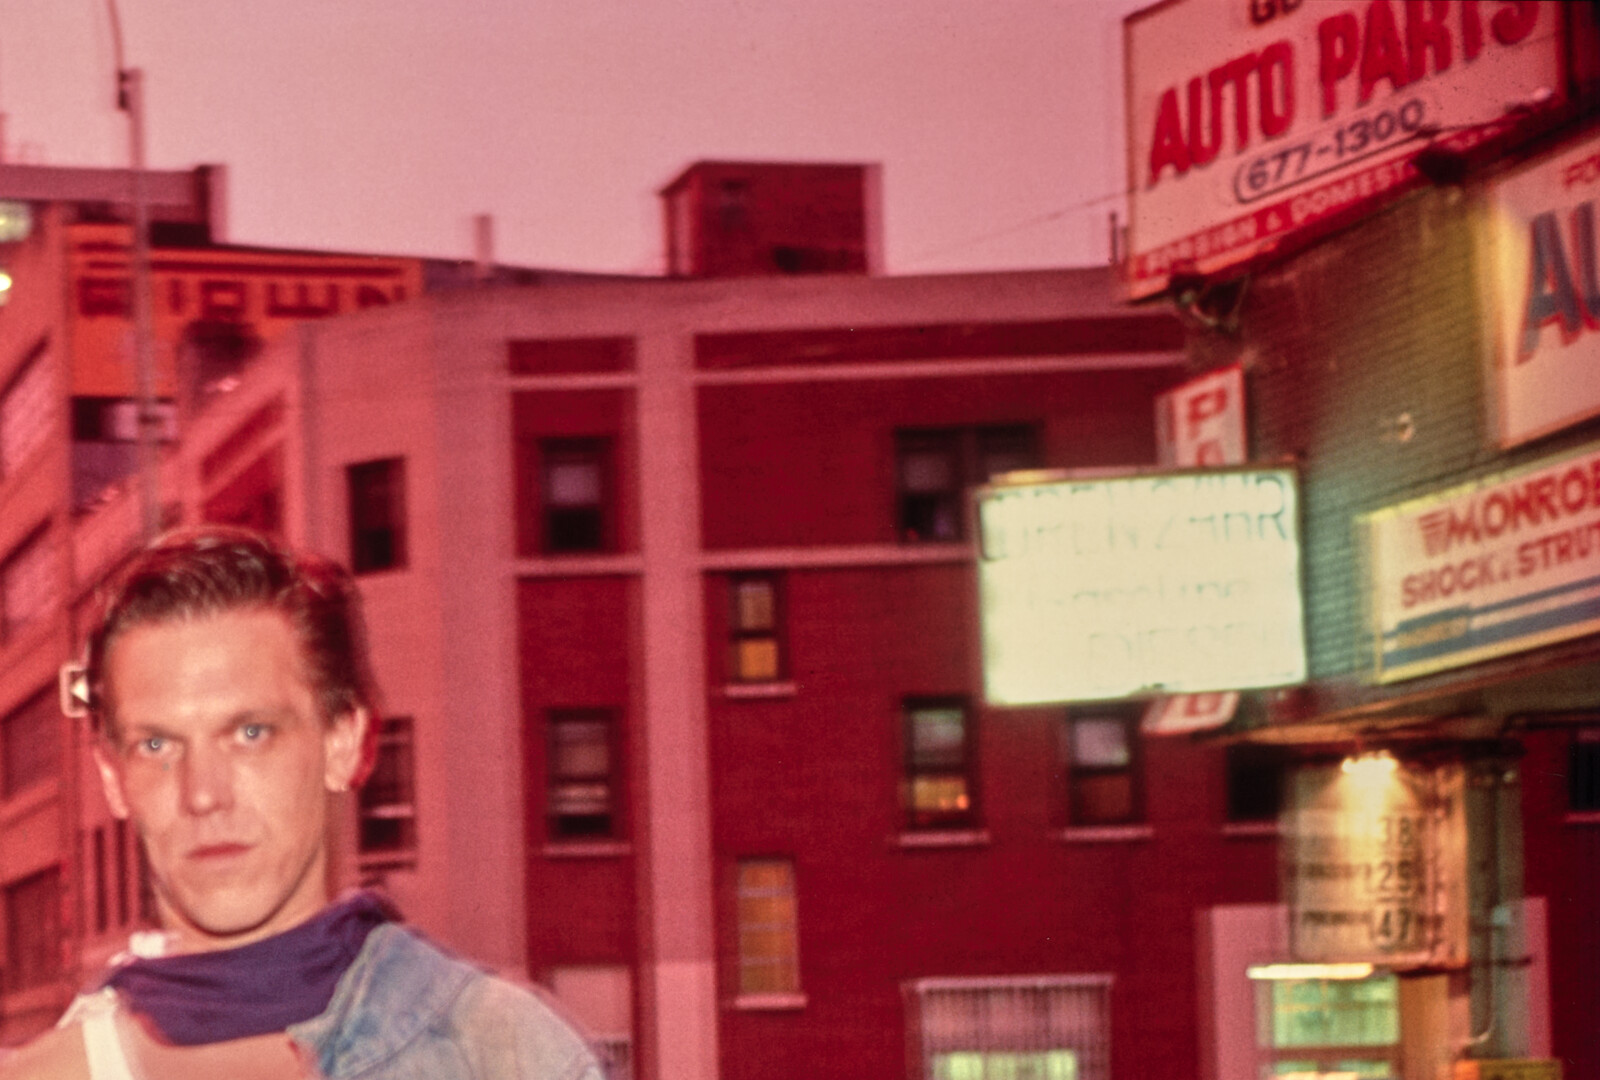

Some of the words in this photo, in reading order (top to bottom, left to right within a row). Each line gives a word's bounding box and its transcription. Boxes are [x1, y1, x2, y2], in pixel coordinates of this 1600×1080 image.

[1146, 39, 1295, 190] AUTO
[1247, 98, 1425, 191] 677-1300
[1419, 458, 1600, 552] MONRO
